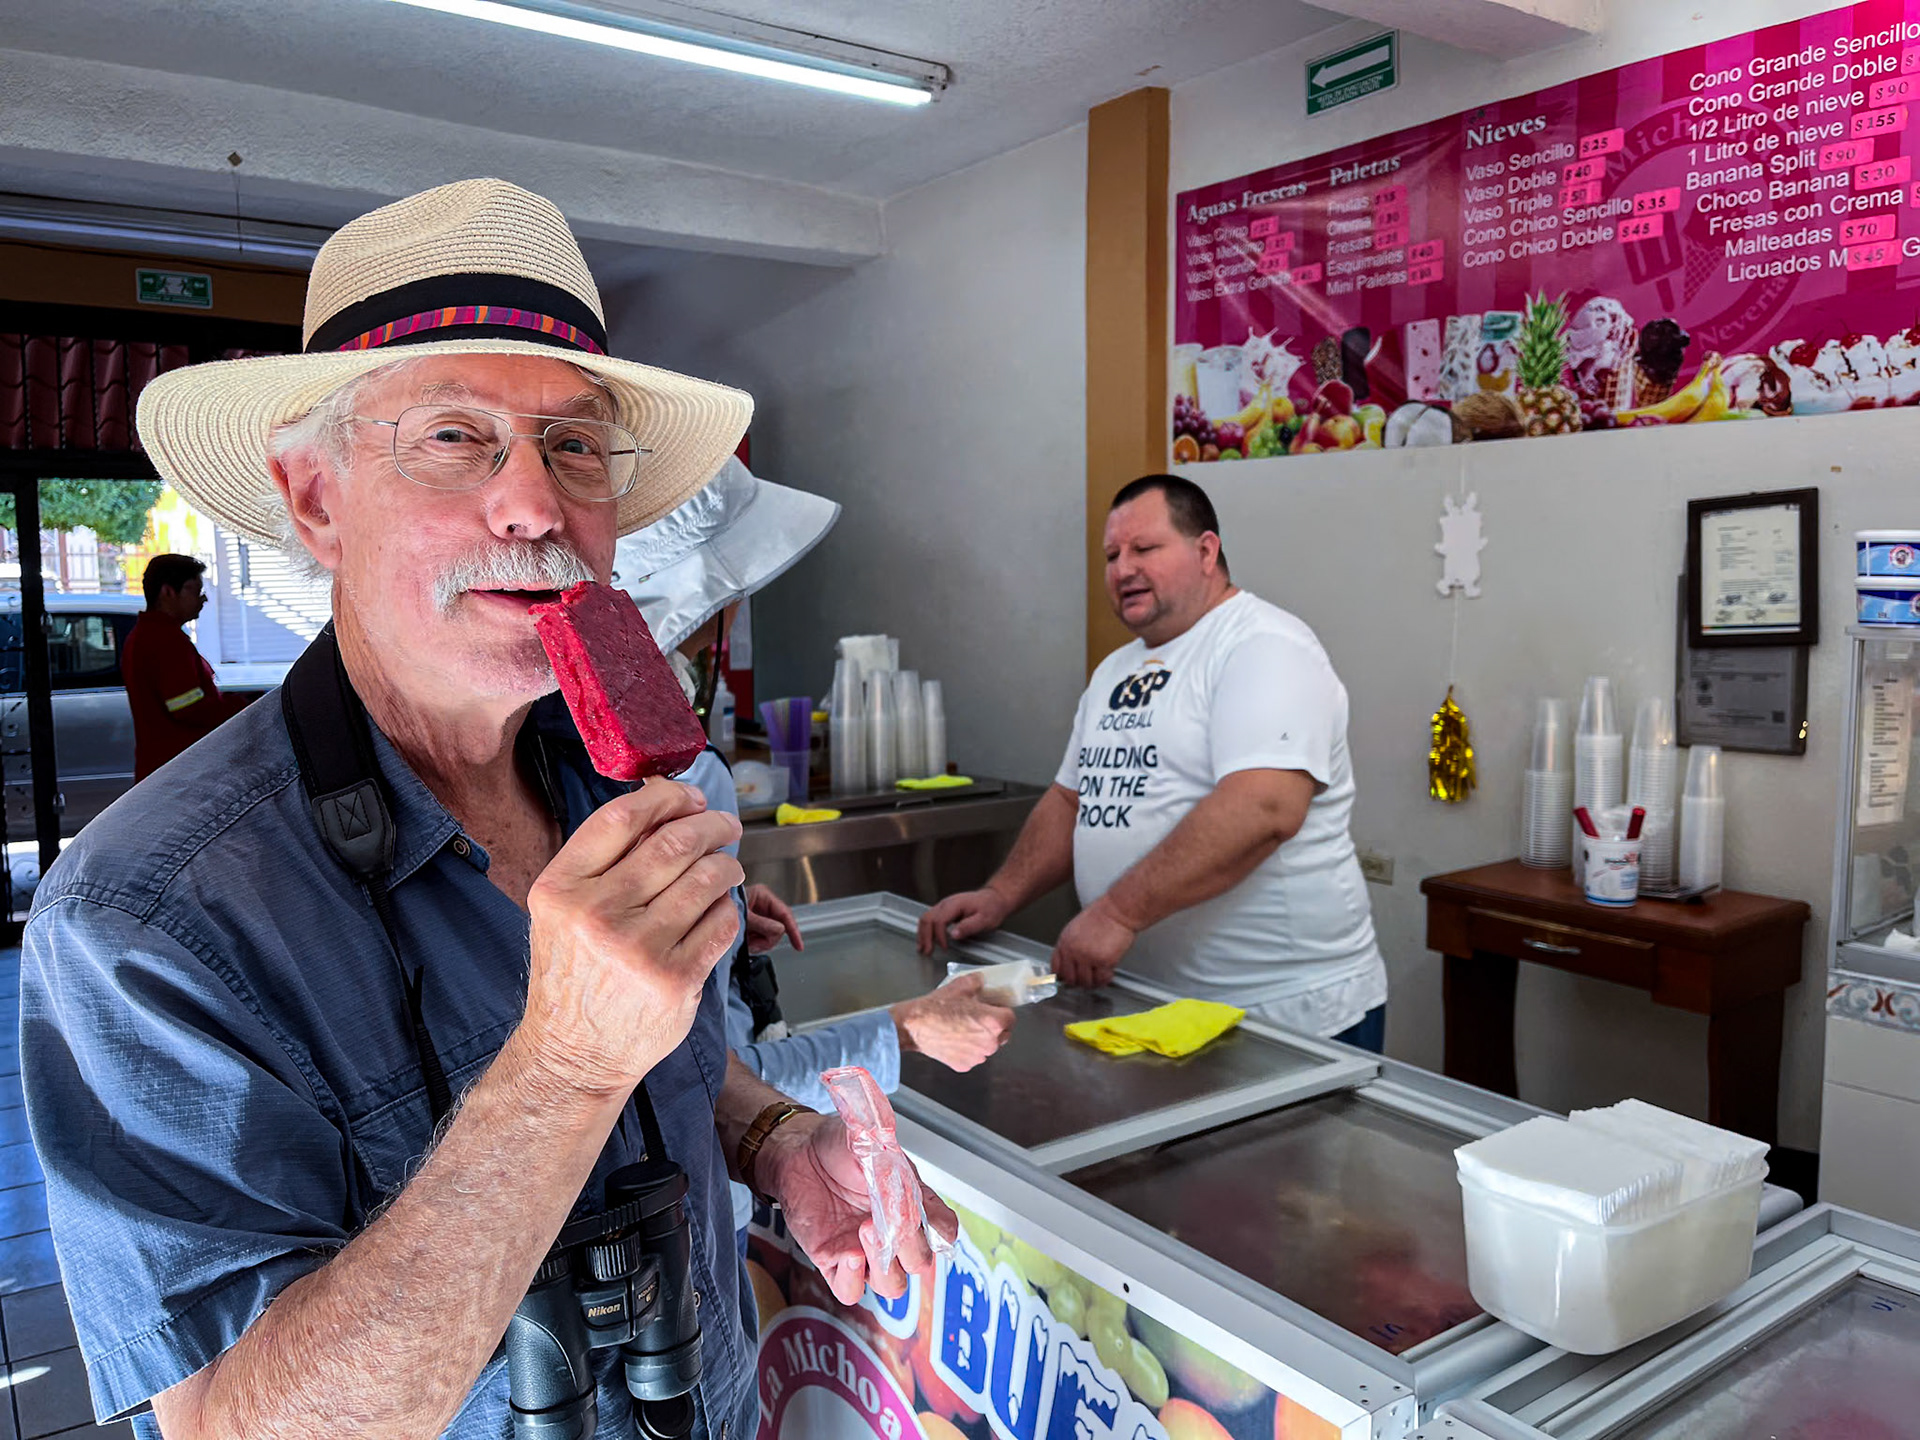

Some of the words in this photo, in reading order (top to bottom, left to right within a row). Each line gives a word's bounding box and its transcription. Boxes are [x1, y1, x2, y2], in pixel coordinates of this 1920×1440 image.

[1689, 66, 1742, 91] Cono
[1748, 45, 1826, 77] Grande
[1833, 21, 1920, 57] Sencillo
[1689, 91, 1742, 117] Cono
[1748, 71, 1825, 102] Grande
[1833, 54, 1897, 84] Doble
[1466, 115, 1547, 149] Nieves
[1688, 119, 1719, 142] 1/2
[1724, 111, 1767, 134] Litro
[1773, 103, 1799, 122] de
[1806, 89, 1864, 115] nieve
[1688, 151, 1696, 167] 1
[1704, 140, 1748, 163] Litro
[1753, 132, 1779, 152] de
[1786, 120, 1844, 146] nieve
[1329, 156, 1400, 186] Paletas
[1465, 161, 1504, 181] Vaso
[1509, 143, 1575, 171] Sencillo
[1686, 162, 1763, 191] Banana
[1769, 149, 1816, 176] Split
[1186, 200, 1237, 225] Aguas
[1242, 182, 1307, 208] Frescas
[1464, 184, 1504, 204] Vaso
[1508, 171, 1556, 194] Doble
[1696, 187, 1762, 213] Choco
[1769, 171, 1850, 199] Banana
[1463, 226, 1506, 246] Cono
[1510, 215, 1558, 237] Chico
[1563, 198, 1632, 225] Sencillo
[1464, 205, 1503, 224] Vaso
[1508, 193, 1553, 215] Triple
[1710, 209, 1778, 236] Fresas
[1784, 202, 1822, 223] con
[1830, 188, 1904, 215] Crema
[1327, 236, 1372, 255] Fresas
[1462, 248, 1505, 268] Cono
[1509, 238, 1557, 259] Chico
[1562, 225, 1614, 249] Doble
[1725, 226, 1833, 258] Malteadas
[1326, 280, 1353, 296] Mini
[1356, 270, 1408, 290] Paletas
[1728, 255, 1821, 282] Licuados
[1078, 745, 1158, 768] BUILDING
[1079, 775, 1104, 797] ON
[1110, 775, 1148, 797] THE
[1080, 804, 1132, 828] ROCK
[588, 1303, 621, 1318] Nikon
